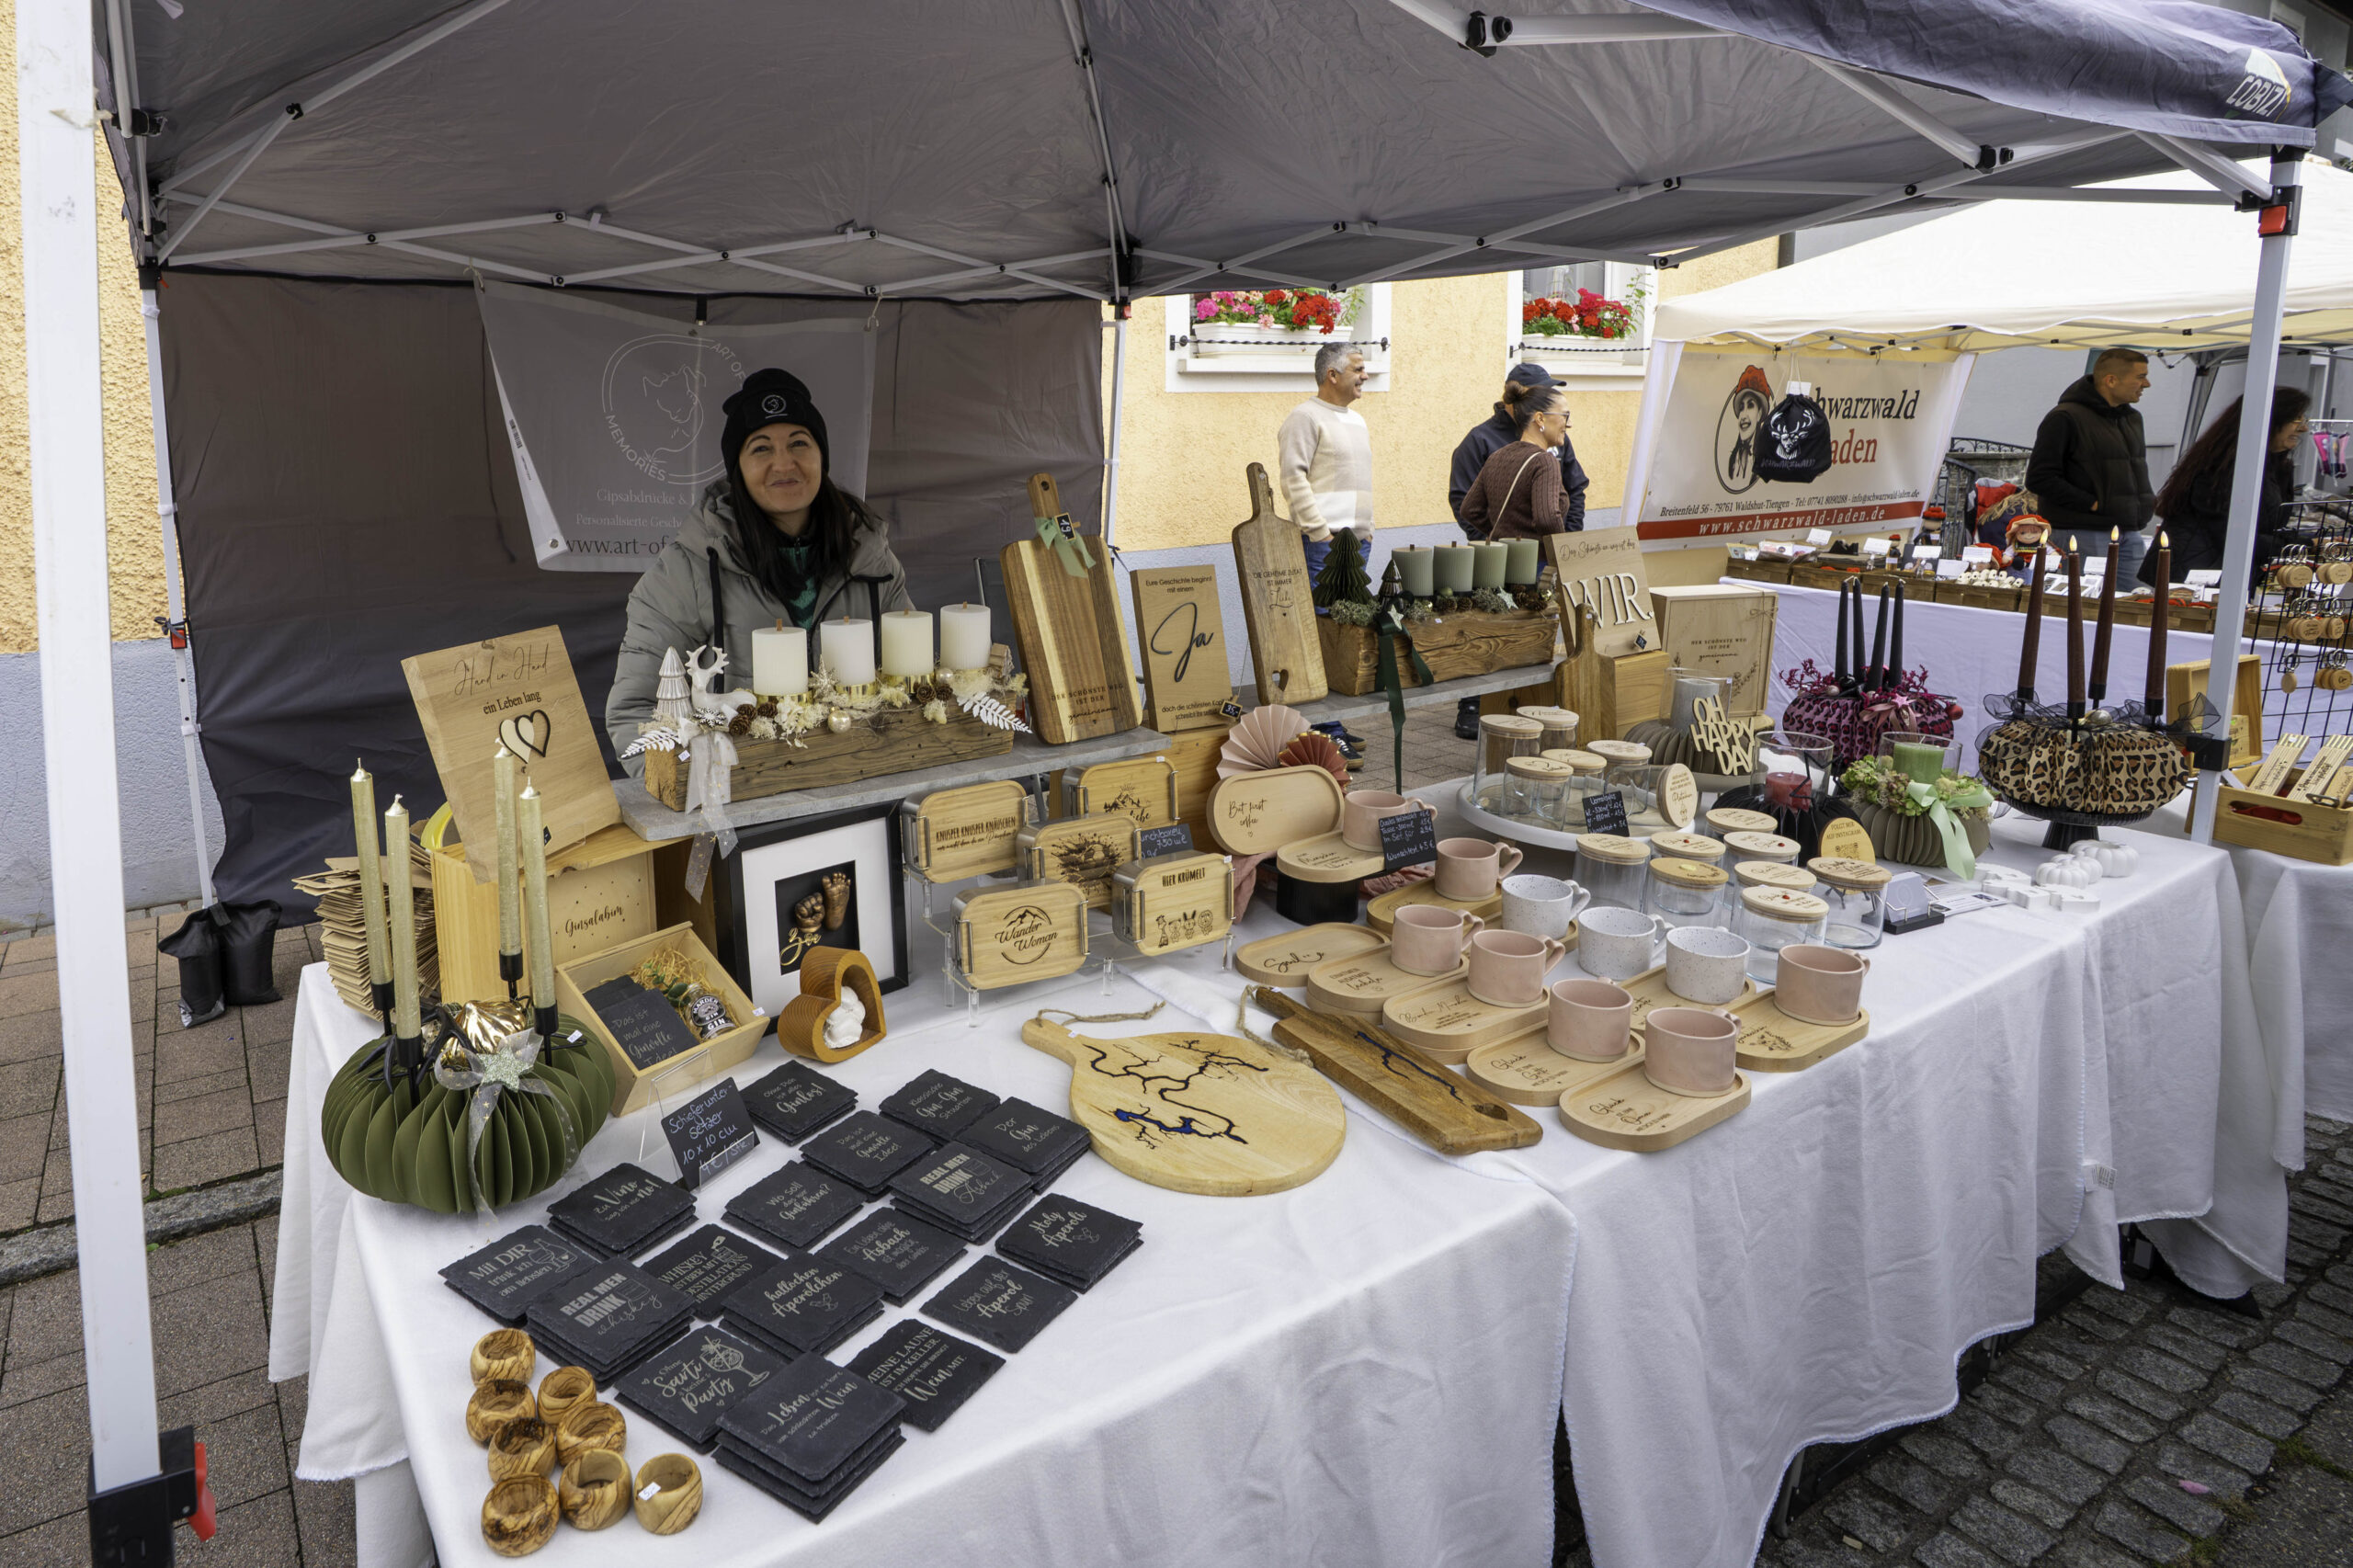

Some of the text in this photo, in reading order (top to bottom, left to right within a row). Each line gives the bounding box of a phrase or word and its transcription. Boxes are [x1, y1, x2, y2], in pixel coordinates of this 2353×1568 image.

[2225, 74, 2287, 117] COBIZI
[710, 343, 747, 381] ART OF
[1810, 387, 1920, 420] hwarzwald
[605, 415, 666, 482] MEMORIES
[1831, 428, 1878, 464] aden
[597, 488, 676, 506] Gipsabdrücke
[678, 494, 688, 505] &
[1660, 506, 1699, 517] Breitenfeld
[1699, 506, 1708, 515] 56
[1714, 503, 1733, 513] 79761
[1734, 499, 1790, 512] Waldshut-Tiengen
[1795, 497, 1806, 507] Tel:
[576, 514, 648, 528] Personalisierte
[1699, 507, 1886, 536] www.schwarzwald-laden.de
[1158, 576, 1191, 585] Geschichte
[1191, 575, 1212, 585] beginnt
[1562, 573, 1654, 629] WIR.
[1151, 601, 1214, 683] Ja
[453, 642, 551, 697] Hand in Hand
[483, 690, 543, 715] ein Leben lang
[1051, 683, 1124, 702] DER SCHÖNSTE WEG
[1075, 695, 1106, 706] IST DER
[1068, 706, 1119, 724] gemeinsame
[1693, 694, 1727, 724] OH
[1689, 717, 1756, 753] HAPPY
[1717, 744, 1755, 776] DAY
[1229, 799, 1267, 819] But first
[1239, 816, 1258, 828] coffee
[936, 815, 1017, 843] KNUSPER KNUSPER KNÄUSCHEN
[1141, 827, 1183, 842] unchboxen
[1830, 822, 1845, 831] FOLGT
[1836, 829, 1861, 839] INSTAGRAM
[1162, 867, 1206, 887] HIER KRÜMELT
[564, 903, 624, 937] Ginsalabim
[995, 921, 1043, 945] Wander
[1014, 930, 1059, 953] Woman
[612, 1008, 649, 1029] Das ist
[692, 995, 720, 1016] MARDER
[705, 1011, 719, 1021] GIN
[623, 1019, 662, 1042] mal eine
[707, 1017, 726, 1031] GIN
[628, 1031, 673, 1058] Ginvolle
[776, 1082, 827, 1115] Ginlos!
[915, 1086, 965, 1119] Gin-Gin
[938, 1096, 973, 1119] Situation
[688, 1110, 722, 1140] setzer
[995, 1117, 1017, 1131] Der
[1009, 1124, 1040, 1141] Gin
[1021, 1124, 1060, 1153] des Lebens
[683, 1133, 717, 1165] 10 10
[837, 1133, 855, 1145] Das
[848, 1131, 879, 1152] mal eine
[856, 1135, 892, 1159] Ginvolle
[871, 1142, 903, 1163] Idee!
[919, 1153, 972, 1186] REAL MEN
[932, 1168, 973, 1195] DRINK
[593, 1179, 639, 1207] Vino
[638, 1179, 662, 1199] no!
[766, 1180, 803, 1208] Wo soll
[779, 1183, 833, 1221] Ginführen?
[1029, 1210, 1066, 1235] Holy
[1041, 1210, 1088, 1248] Aperoli
[862, 1227, 911, 1262] Asbach
[469, 1244, 534, 1280] Mit DIR
[488, 1260, 532, 1287] trink ich
[658, 1250, 708, 1285] WHISKEY
[687, 1258, 721, 1285] BIER MIT
[687, 1253, 749, 1295] DESTILLATIONS
[498, 1265, 553, 1297] am liebsten
[560, 1272, 629, 1316] REAL MEN
[695, 1262, 754, 1304] HINTERGRUND
[764, 1267, 820, 1302] hallöchen
[770, 1270, 843, 1318] Aperölchen
[574, 1294, 627, 1328] DRINK
[952, 1289, 983, 1312] Leben
[977, 1278, 1024, 1320] Aperol
[597, 1293, 663, 1336] whiskey
[895, 1326, 936, 1358] LAUNE
[658, 1358, 682, 1377] Ohne
[879, 1338, 941, 1388] IST IM KELLER.
[893, 1343, 949, 1393] ICH HOFFE BRINGT
[653, 1358, 704, 1398] Sarti
[904, 1355, 968, 1402] Wein MIT.
[681, 1376, 737, 1414] Party
[815, 1381, 858, 1410] Wein
[760, 1393, 811, 1435] Das Leben
[816, 1412, 840, 1431] trinken
